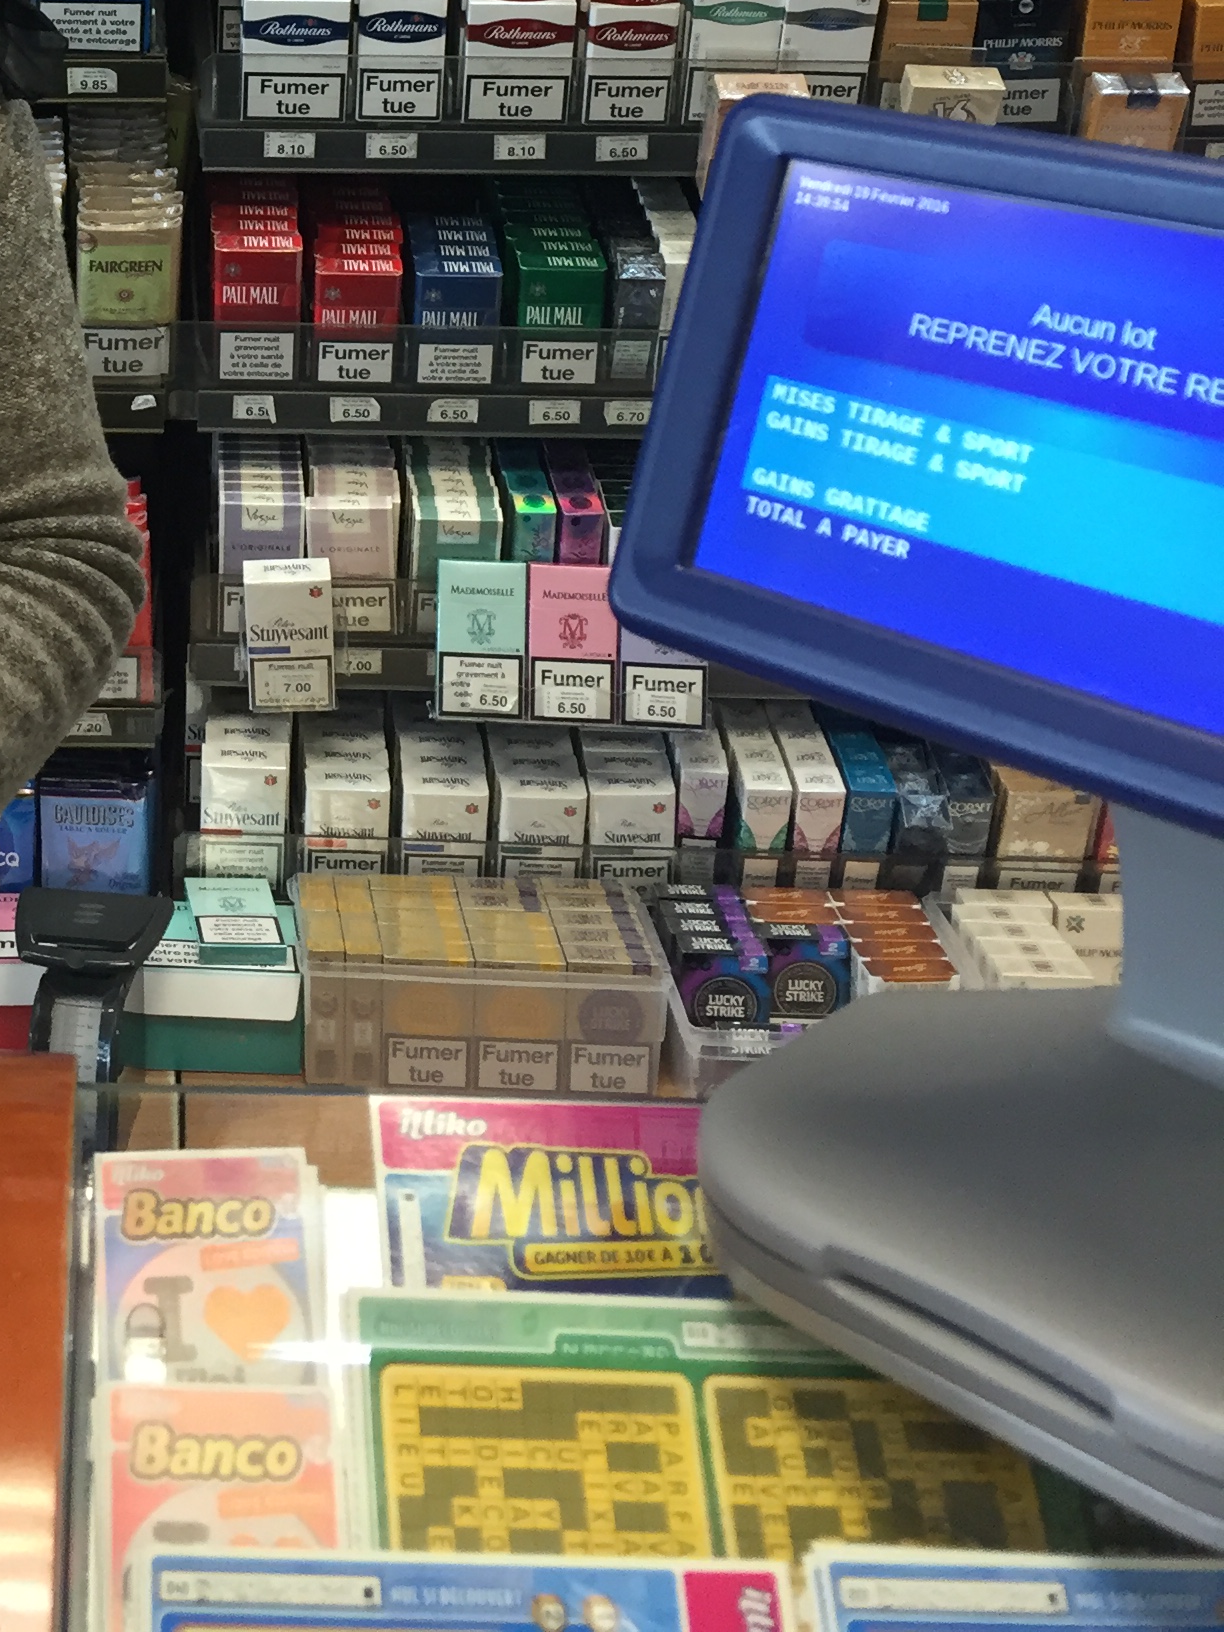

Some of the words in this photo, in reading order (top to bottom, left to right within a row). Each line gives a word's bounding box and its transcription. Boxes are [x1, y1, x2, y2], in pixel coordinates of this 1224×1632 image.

[259, 20, 333, 37] Rothmans
[596, 26, 670, 43] Rothmans
[260, 79, 330, 96] Fumer
[276, 98, 311, 115] tue
[276, 143, 305, 157] 8.10
[88, 258, 164, 275] FAIRGREEN
[222, 286, 248, 305] PALL
[249, 286, 279, 306] MALL
[1031, 303, 1115, 345] Aucun
[1122, 318, 1158, 352] lot
[321, 344, 390, 363] Fumer
[908, 311, 1066, 370] REPRENEZ
[1070, 347, 1181, 397] VOTRE
[338, 364, 372, 382] tue
[541, 408, 570, 422] 6.50
[772, 382, 836, 415] MISES
[848, 400, 925, 439] TIRAGE
[962, 431, 1034, 465] SPORT
[765, 409, 830, 443] GAINS
[841, 429, 918, 467] TIRAGE
[955, 460, 1028, 495] SPORT
[751, 466, 816, 500] GAINS
[825, 486, 931, 533] GRATTAGE
[745, 496, 807, 531] TOTAL
[816, 516, 833, 537] A
[841, 523, 911, 561] PAYER
[450, 583, 515, 597] MADEMOISELLE
[250, 621, 330, 642] Stuyvesant
[557, 701, 587, 715] 6.50
[392, 1042, 464, 1063] Fumer
[408, 1065, 444, 1085] tue
[399, 1107, 487, 1138] illiko
[122, 1190, 274, 1240] Banco
[533, 1249, 601, 1266] GAGNER
